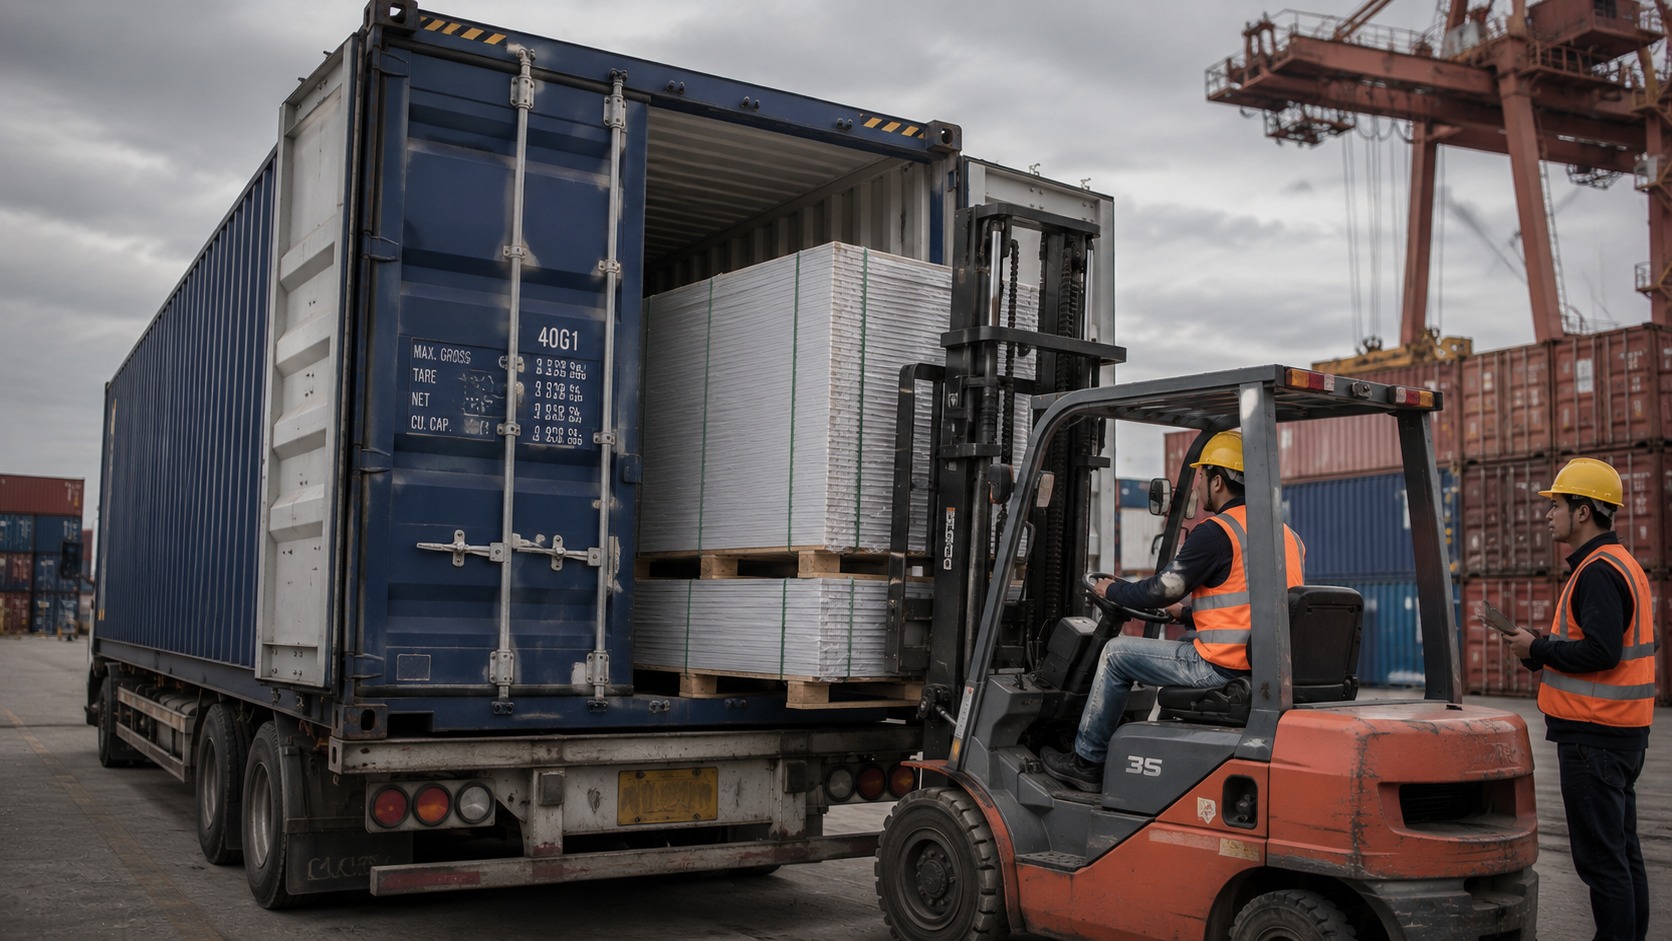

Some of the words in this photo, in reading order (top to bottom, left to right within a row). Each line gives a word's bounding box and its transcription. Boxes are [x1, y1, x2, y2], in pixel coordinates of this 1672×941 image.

[537, 326, 579, 351] 40G1
[413, 344, 437, 361] MAX.
[412, 368, 437, 384] TARE
[411, 392, 431, 407] NET
[411, 415, 427, 430] CU.
[429, 417, 452, 432] CAP.
[1125, 755, 1163, 777] 35
